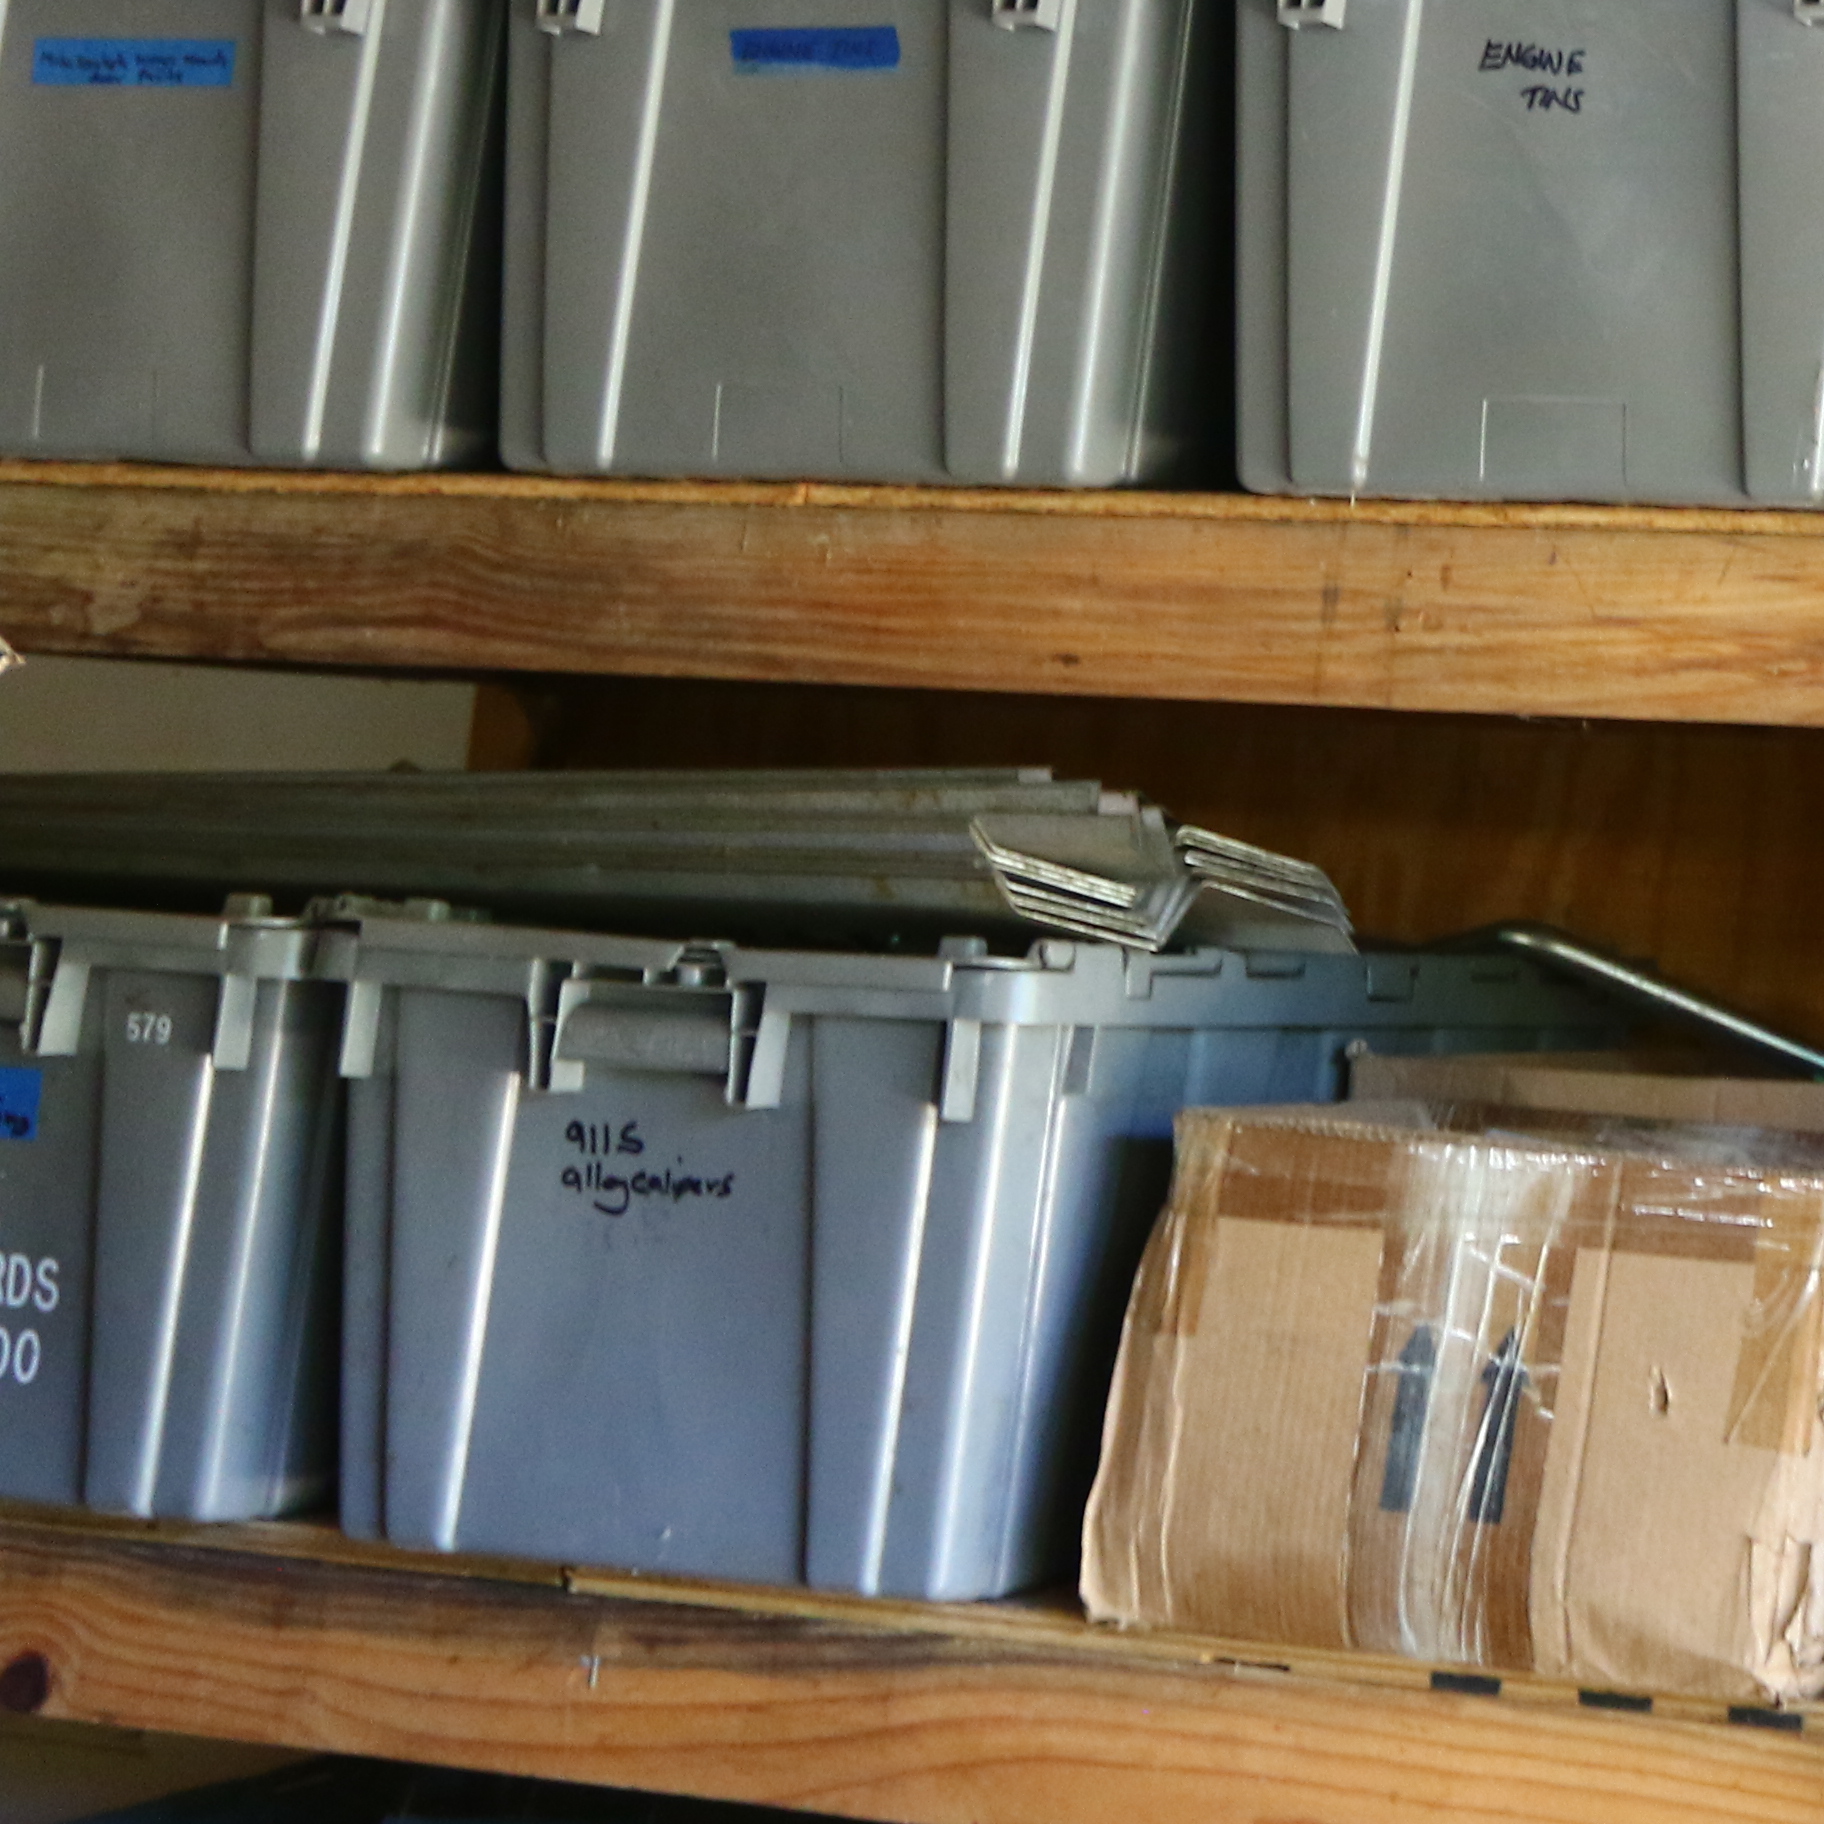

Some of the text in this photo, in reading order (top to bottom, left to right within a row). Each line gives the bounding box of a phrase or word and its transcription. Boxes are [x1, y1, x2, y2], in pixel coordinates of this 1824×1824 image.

[1479, 39, 1587, 78] ENGINE
[1521, 84, 1586, 114] TINS
[127, 1011, 172, 1045] 579
